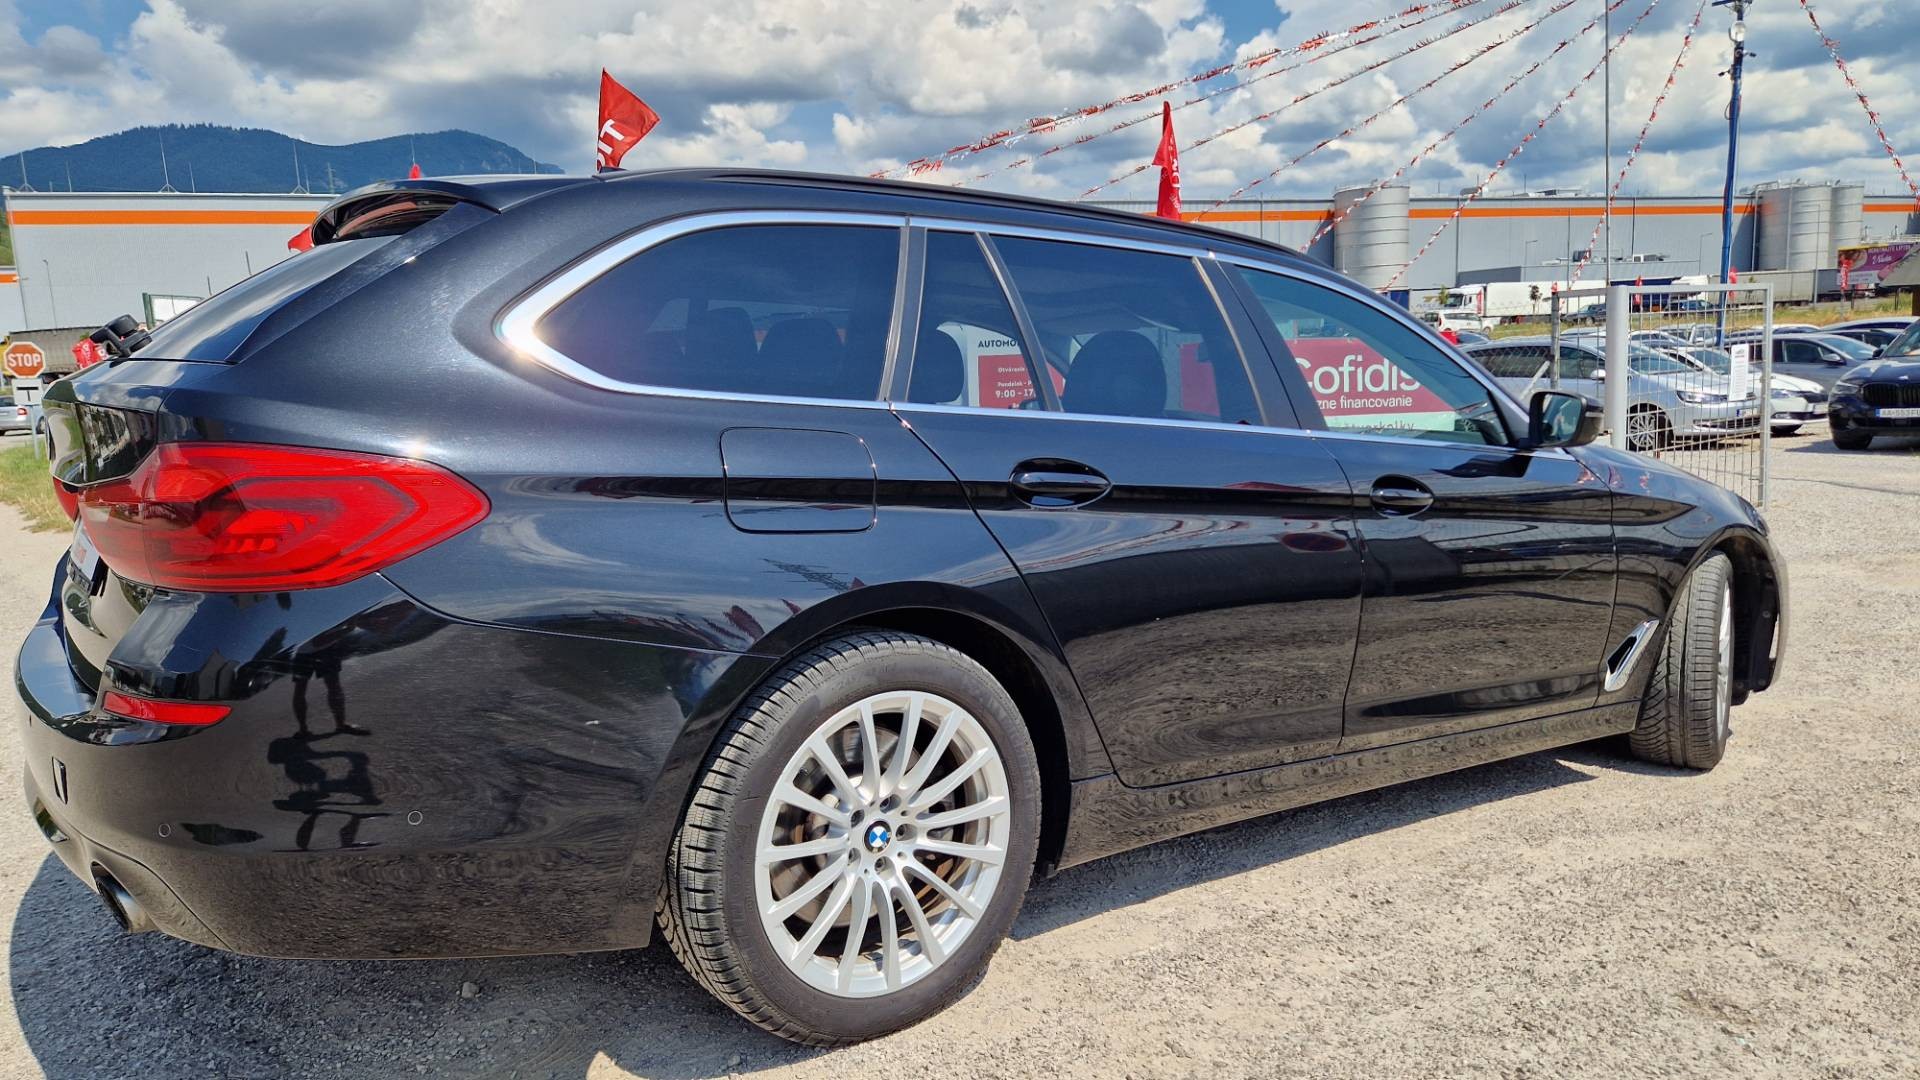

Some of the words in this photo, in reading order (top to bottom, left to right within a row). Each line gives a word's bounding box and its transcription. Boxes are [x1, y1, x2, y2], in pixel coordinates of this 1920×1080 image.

[8, 353, 41, 367] STOP
[995, 389, 1015, 398] 9:00
[1340, 395, 1412, 409] financovanie
